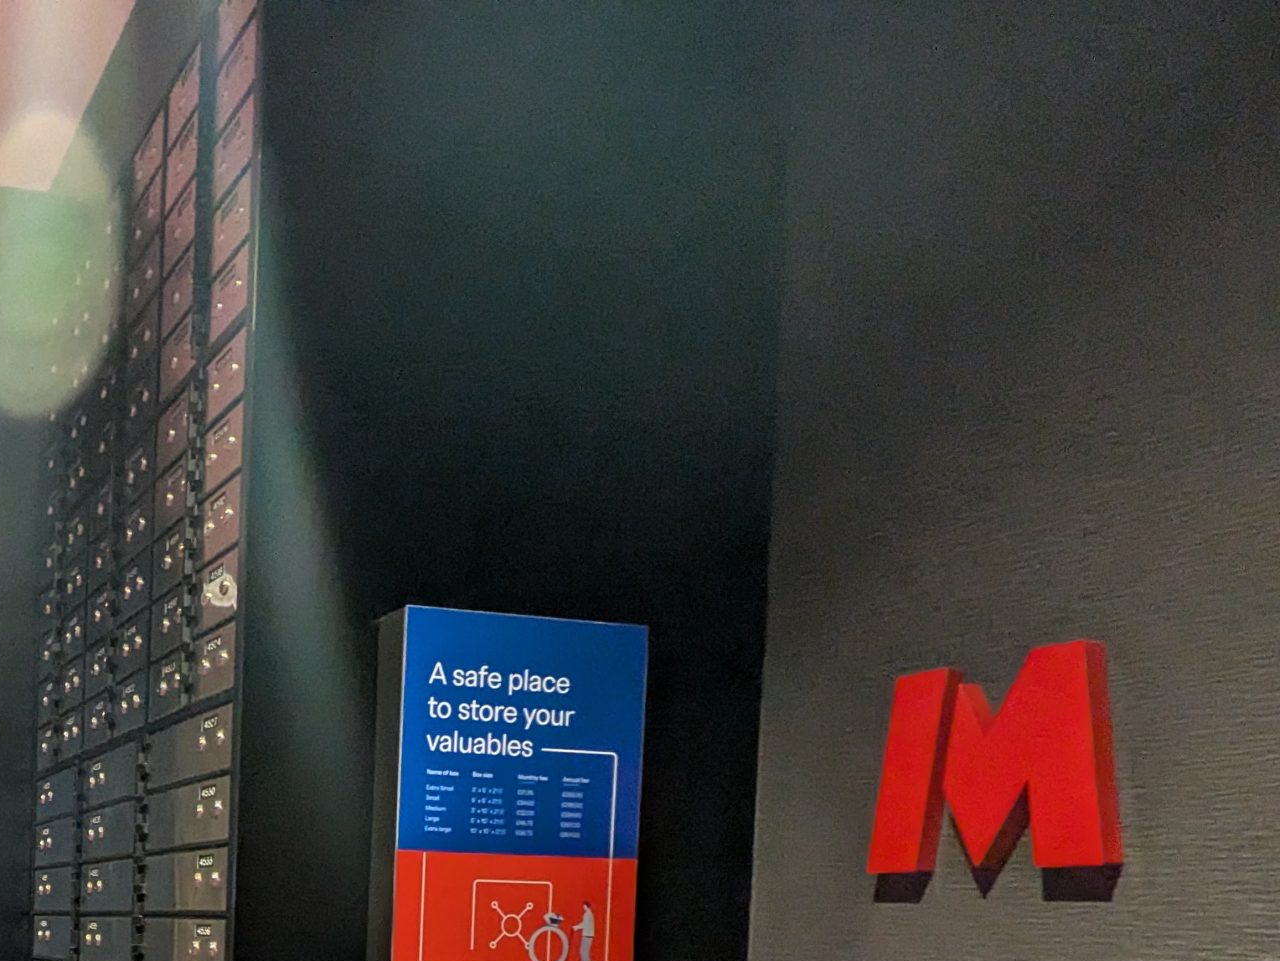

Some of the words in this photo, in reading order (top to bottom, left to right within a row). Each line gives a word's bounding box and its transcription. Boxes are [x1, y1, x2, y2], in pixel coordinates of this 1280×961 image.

[428, 661, 448, 685] A
[452, 664, 502, 689] safe
[508, 668, 571, 696] place
[427, 696, 452, 719] to
[458, 699, 518, 723] store
[523, 707, 576, 730] your
[426, 730, 534, 757] valuables
[866, 638, 1124, 875] M
